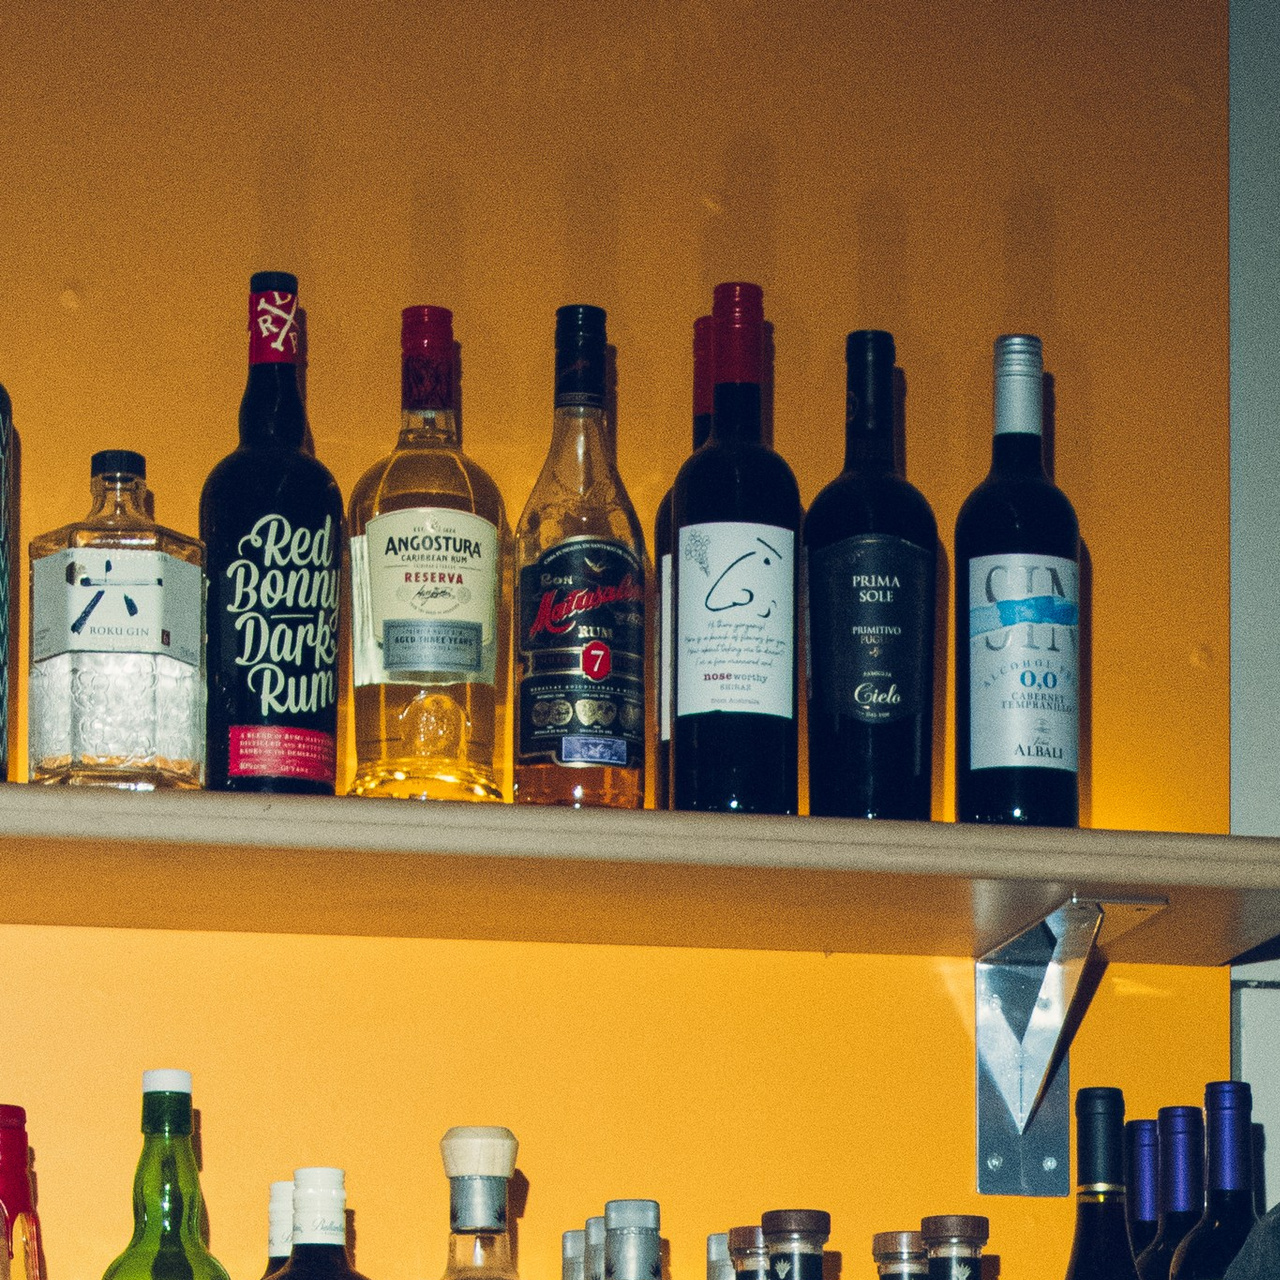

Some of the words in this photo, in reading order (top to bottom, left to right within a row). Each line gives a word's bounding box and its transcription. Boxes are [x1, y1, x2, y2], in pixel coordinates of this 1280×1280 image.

[238, 513, 334, 567] Red
[384, 535, 482, 559] ANGOSTURA
[401, 554, 448, 563] CARIBBEAN
[450, 555, 468, 564] RUM
[404, 571, 464, 585] RESERVA
[852, 574, 901, 588] PRIMA
[70, 558, 164, 635] 六
[226, 559, 341, 632] Bonny
[859, 589, 894, 603] SOLE
[89, 626, 124, 636] ROKU
[126, 626, 150, 636] GIN
[234, 611, 338, 669] Dark
[577, 625, 614, 639] RUM
[852, 625, 902, 636] PRIMITIVO
[394, 635, 416, 645] AGED
[419, 635, 446, 645] THREE
[448, 636, 474, 647] YEARS
[590, 650, 605, 673] 7
[983, 658, 1051, 689] ALCOHOL
[1019, 669, 1058, 691] 0,0
[247, 662, 335, 717] Rum
[853, 682, 901, 705] Cielo
[1011, 692, 1065, 704] CABERNET
[1014, 743, 1064, 760] ALBALI
